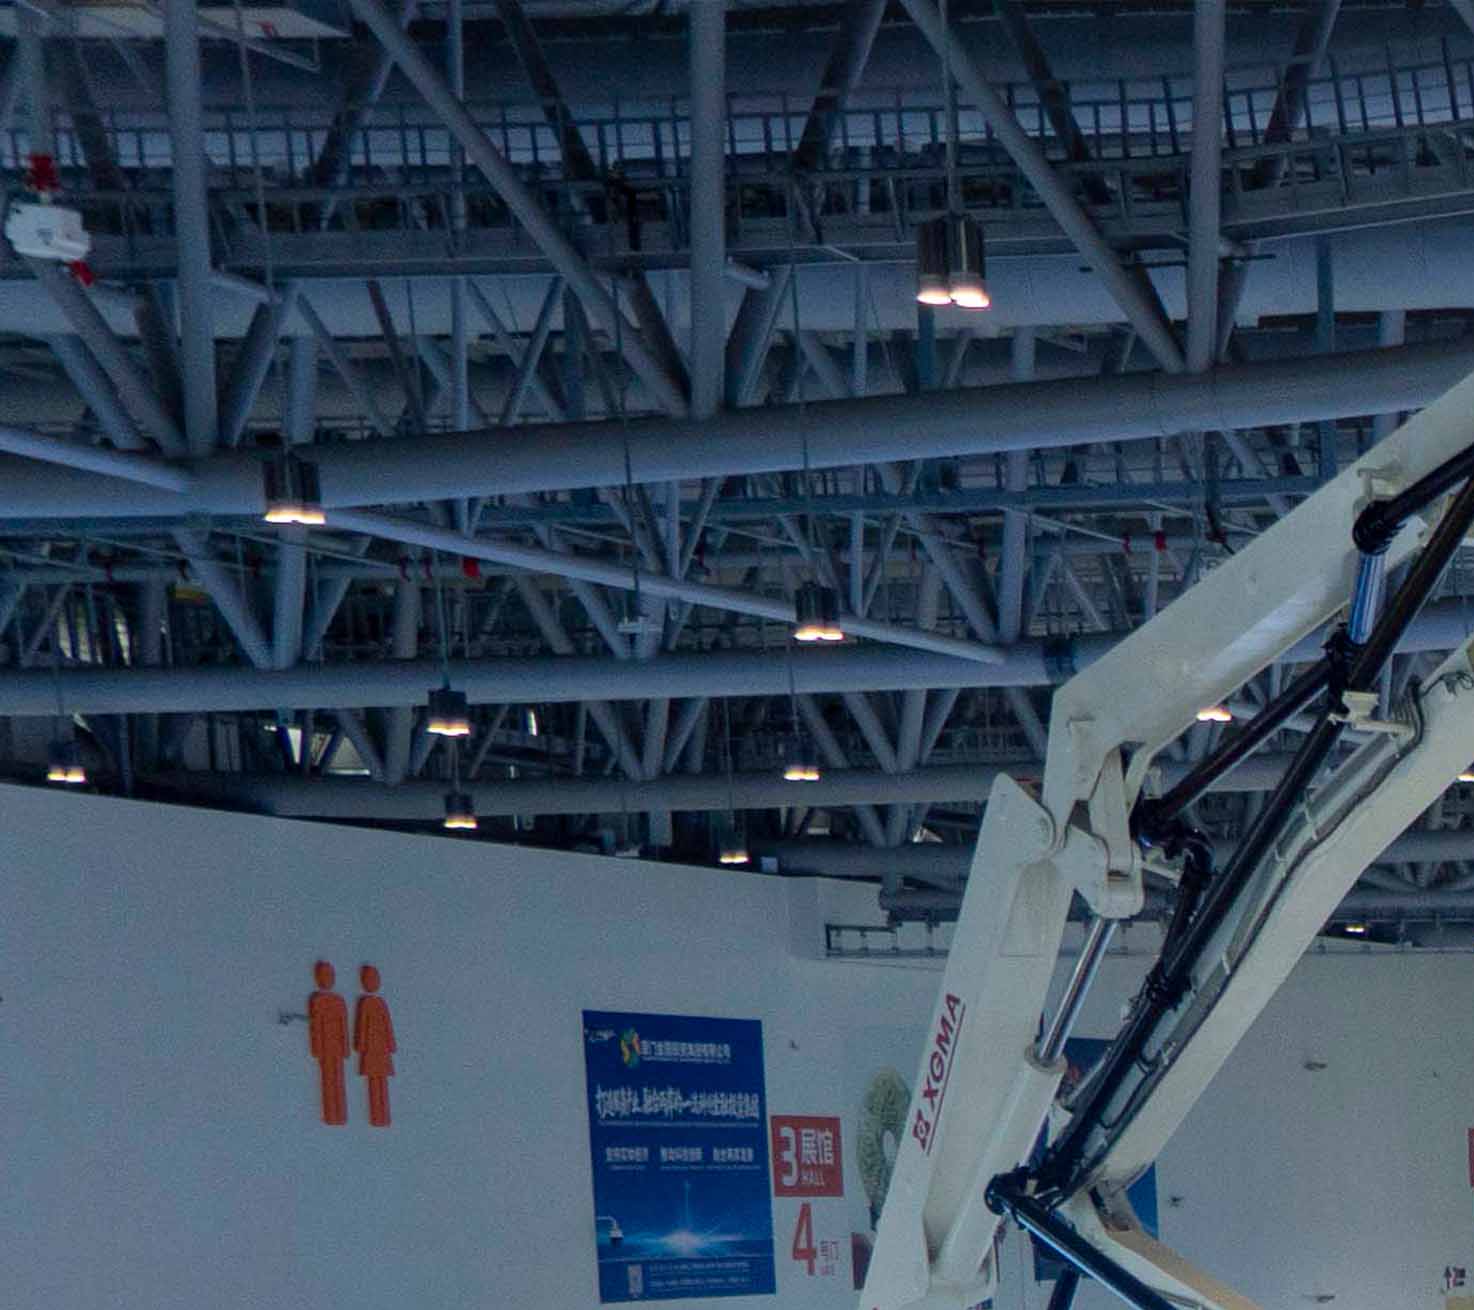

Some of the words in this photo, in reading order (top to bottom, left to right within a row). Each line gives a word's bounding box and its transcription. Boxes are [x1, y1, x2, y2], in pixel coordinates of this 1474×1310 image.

[923, 993, 961, 1110] XGMA
[780, 1127, 798, 1187] 3
[802, 1128, 834, 1165] 展馆
[792, 1203, 817, 1276] 4
